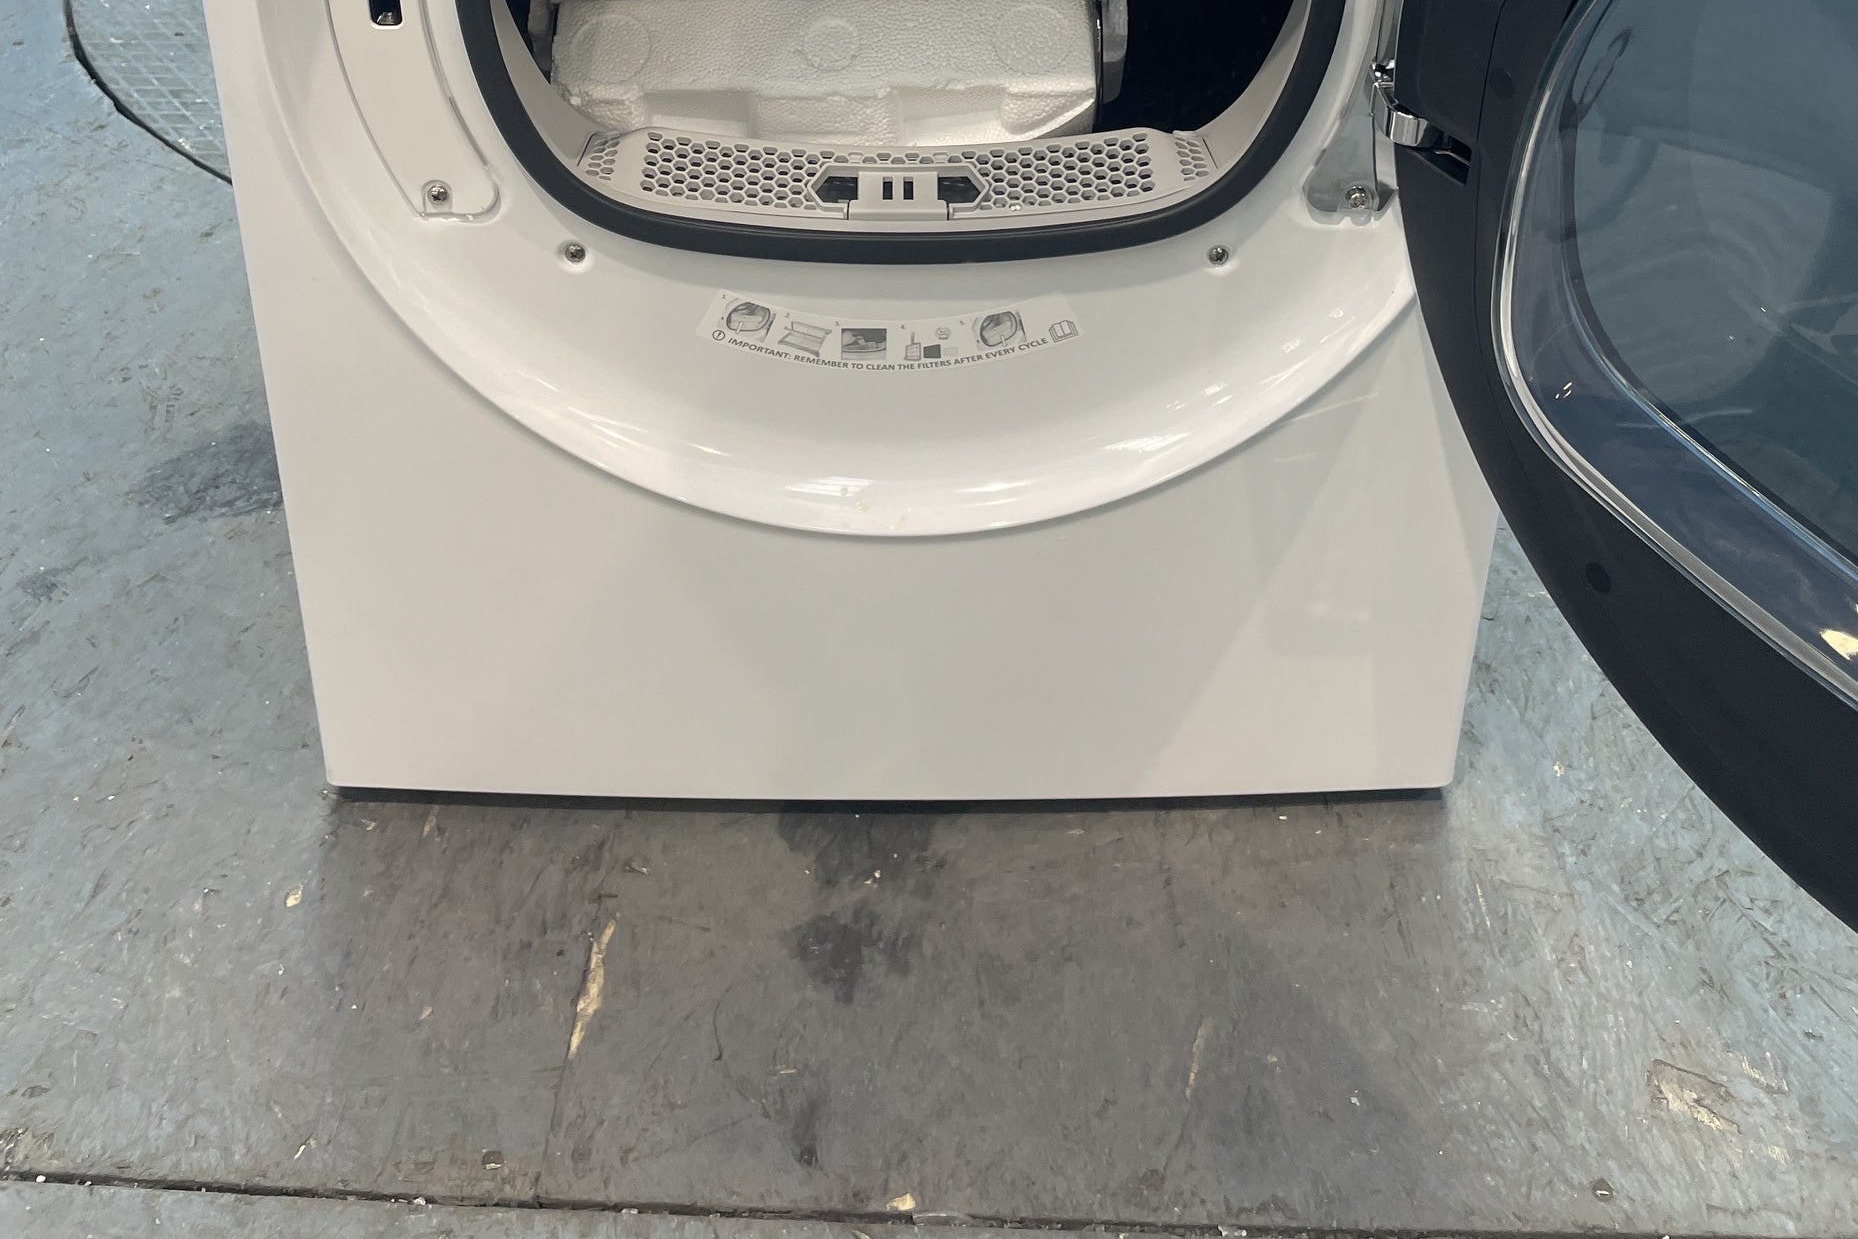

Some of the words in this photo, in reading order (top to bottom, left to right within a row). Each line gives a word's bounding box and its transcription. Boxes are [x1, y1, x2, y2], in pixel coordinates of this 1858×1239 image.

[728, 337, 792, 360] IMPORTANT:
[793, 355, 849, 370] REMEMBER
[851, 362, 864, 370] TO
[865, 363, 896, 371] CLEAN
[897, 362, 916, 371] THE
[917, 359, 952, 370] FILTERS
[953, 354, 984, 366] AFTER
[985, 346, 1016, 361] EVERY
[1018, 337, 1048, 352] CYCLE
